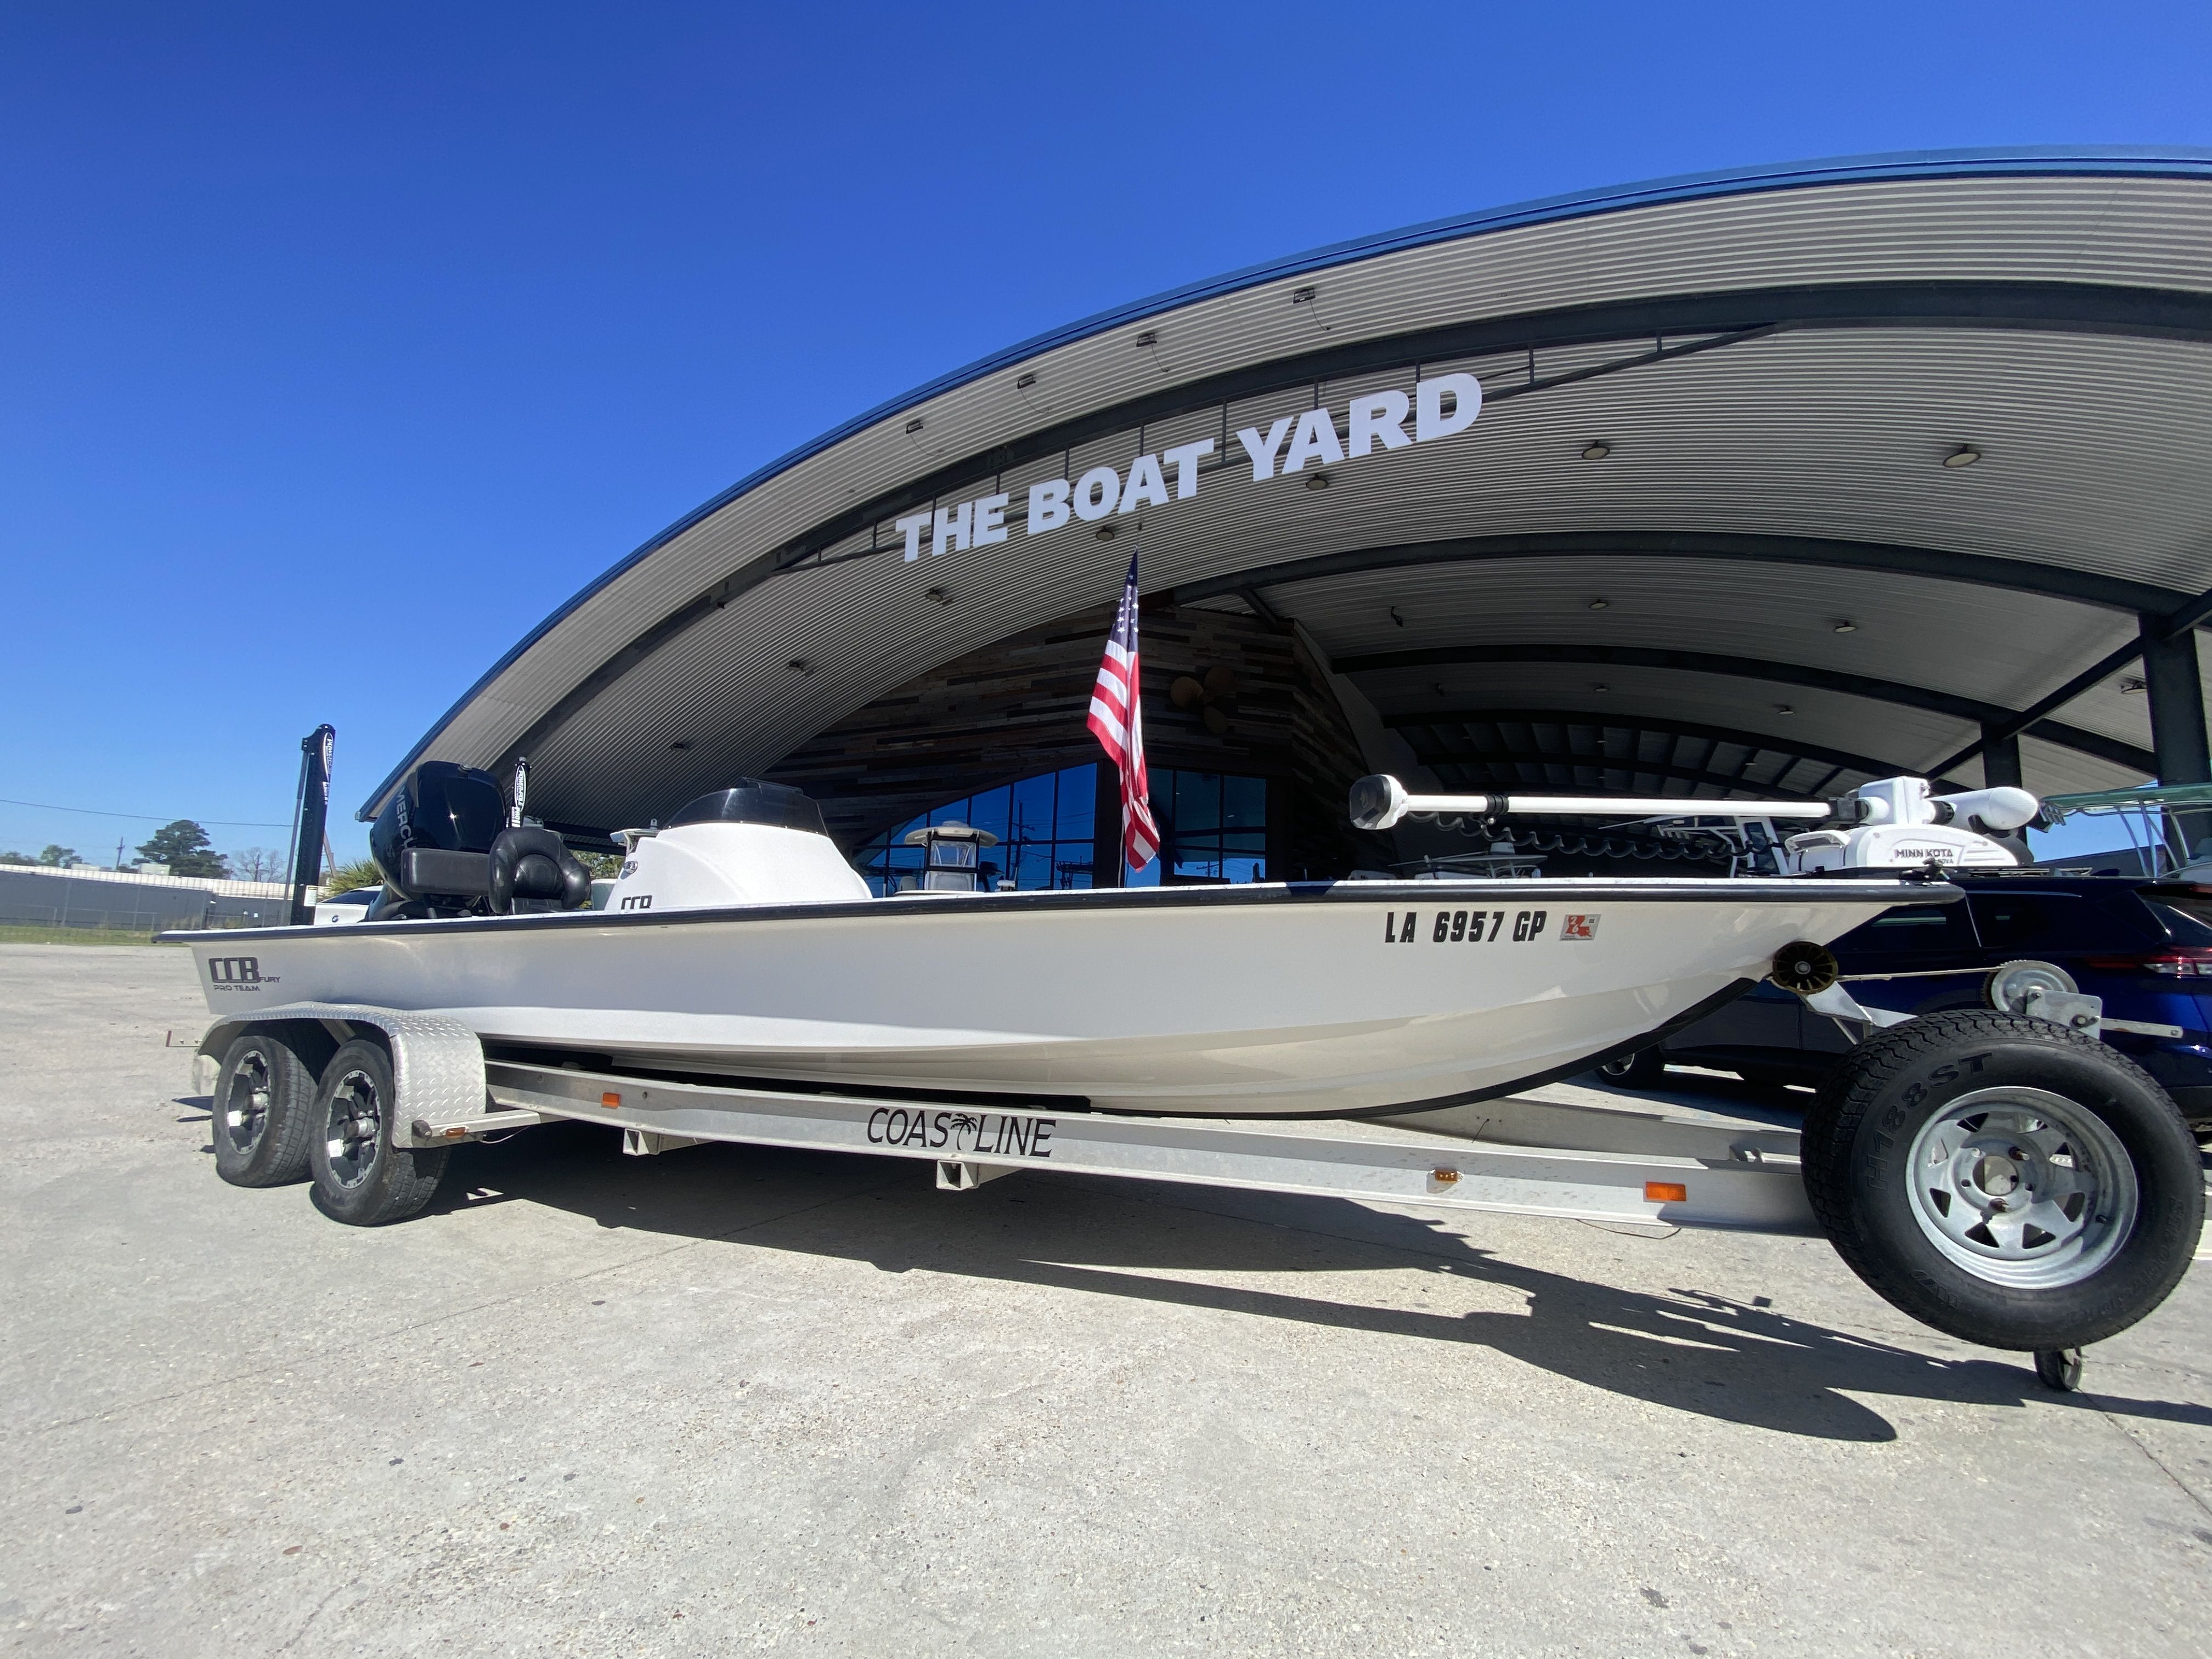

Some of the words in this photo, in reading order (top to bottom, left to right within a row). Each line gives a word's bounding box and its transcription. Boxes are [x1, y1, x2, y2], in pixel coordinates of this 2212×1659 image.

[894, 492, 1009, 562] THE
[1026, 438, 1215, 535] BOAT
[1235, 373, 1483, 482] YARD
[1894, 849, 1923, 857] MINN
[1925, 849, 1953, 857] KOTA
[1385, 911, 1417, 943] LA
[1432, 911, 1505, 943] 6957
[1513, 911, 1547, 942] GP
[208, 957, 261, 984] CCB
[1867, 1052, 1993, 1191] H188ST
